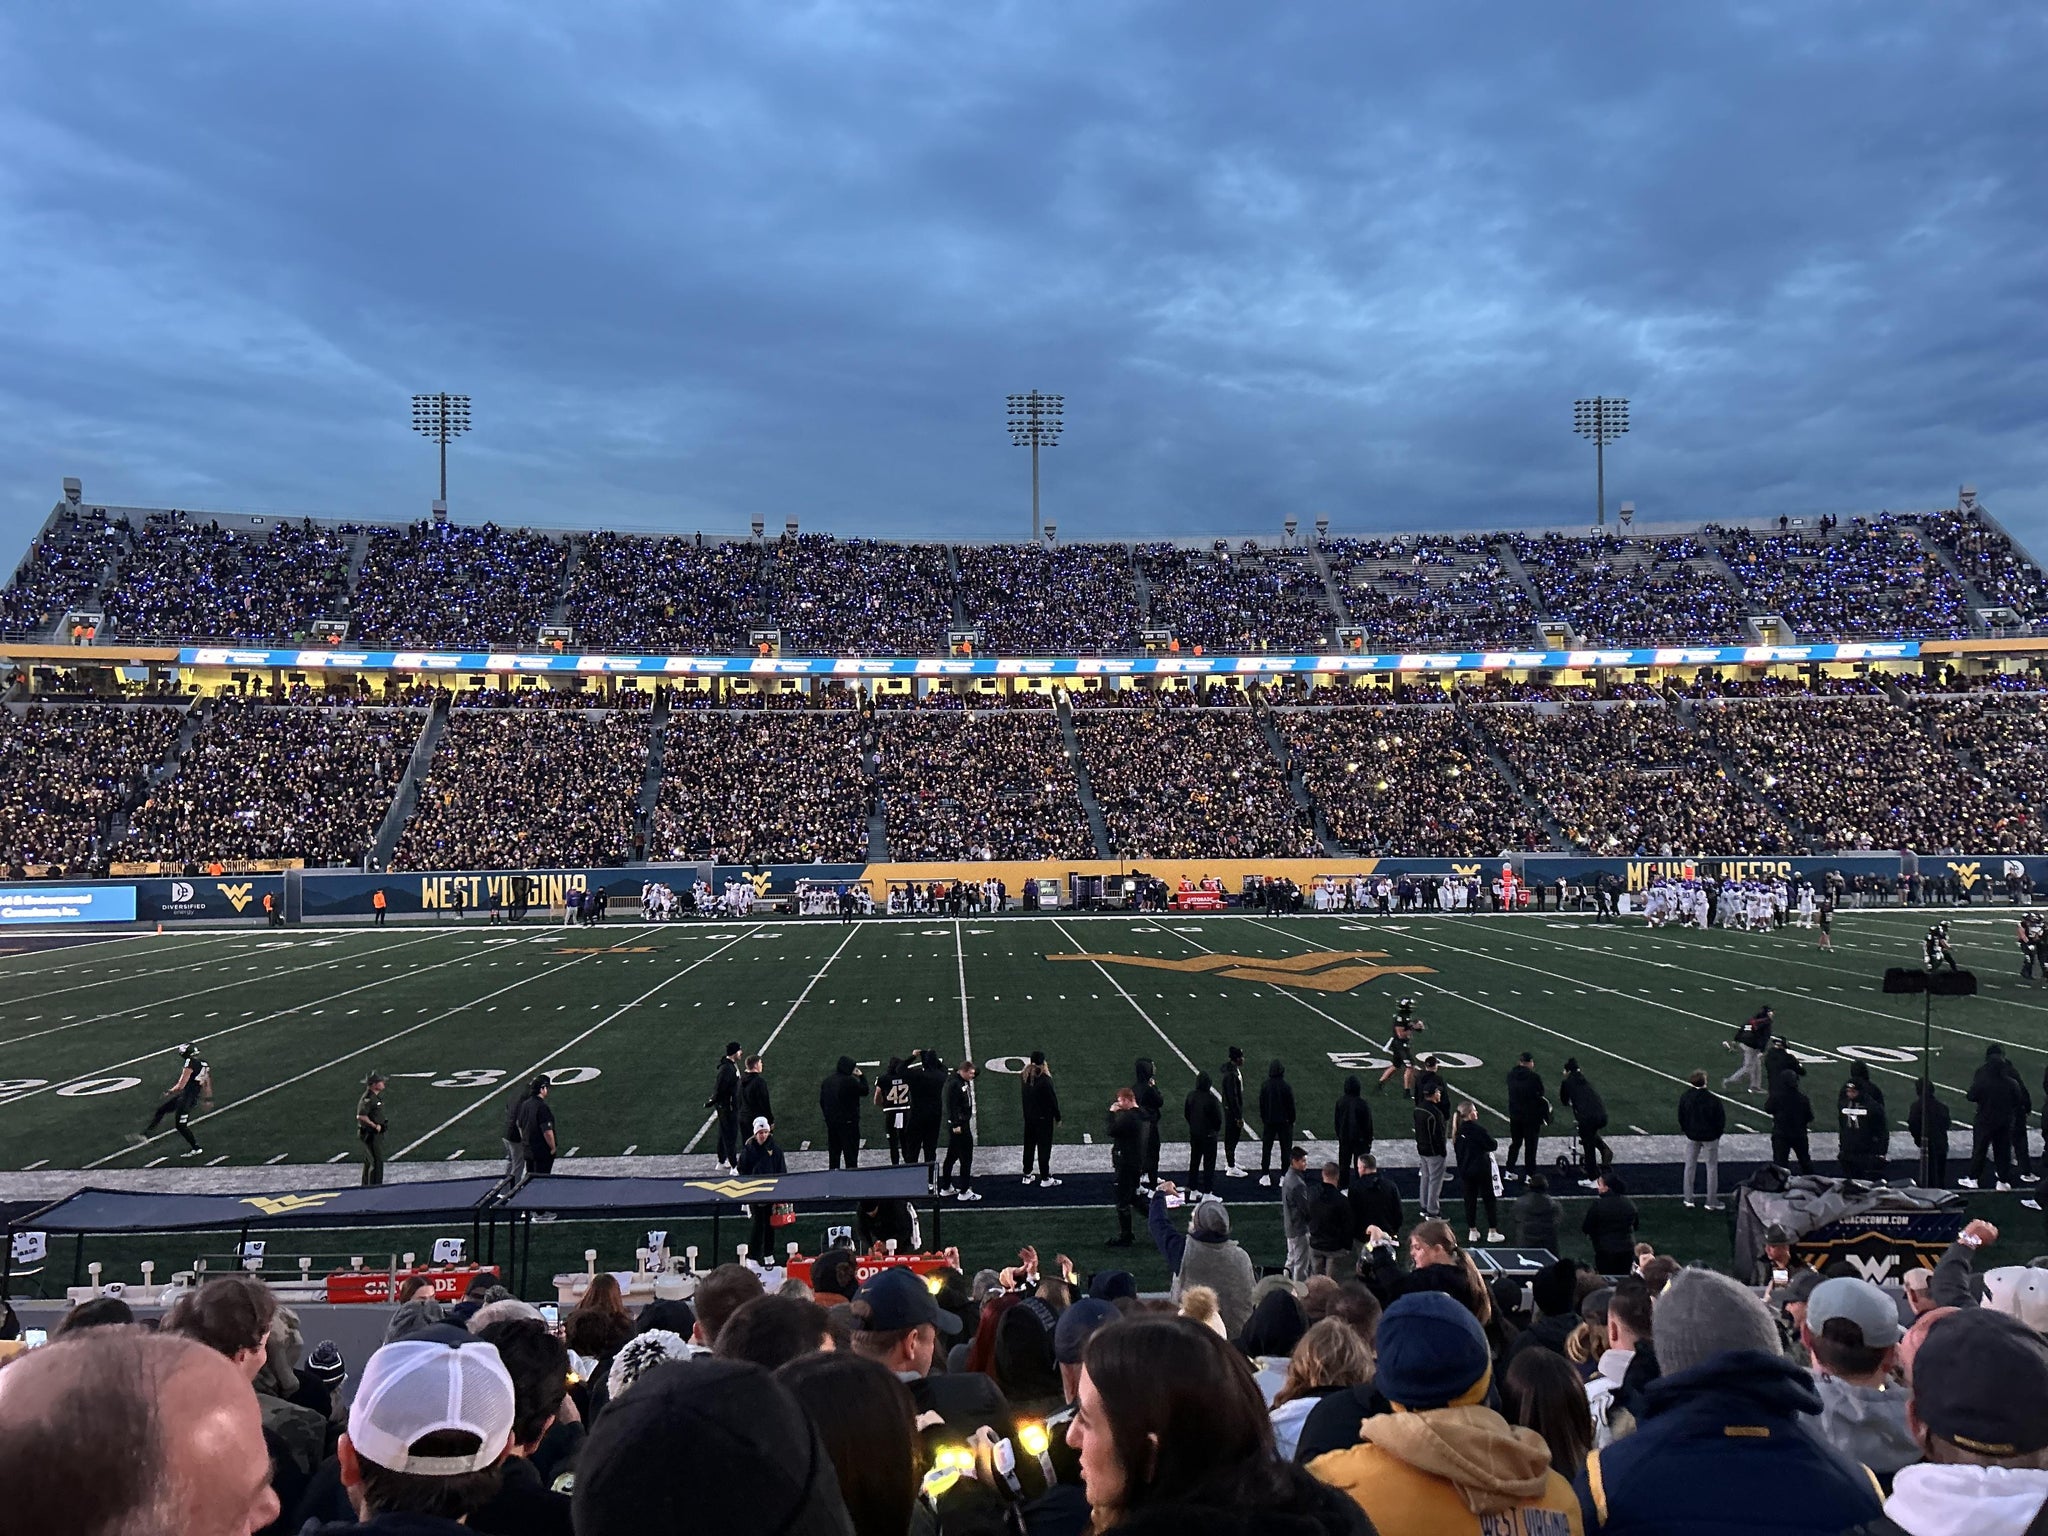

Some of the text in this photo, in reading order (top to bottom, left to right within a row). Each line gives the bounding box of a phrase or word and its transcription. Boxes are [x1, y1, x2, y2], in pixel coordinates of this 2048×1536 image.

[422, 876, 481, 908] WEST
[162, 904, 206, 912] DIVERSIFIED
[1326, 1051, 1484, 1069] 50
[887, 1084, 909, 1105] 42
